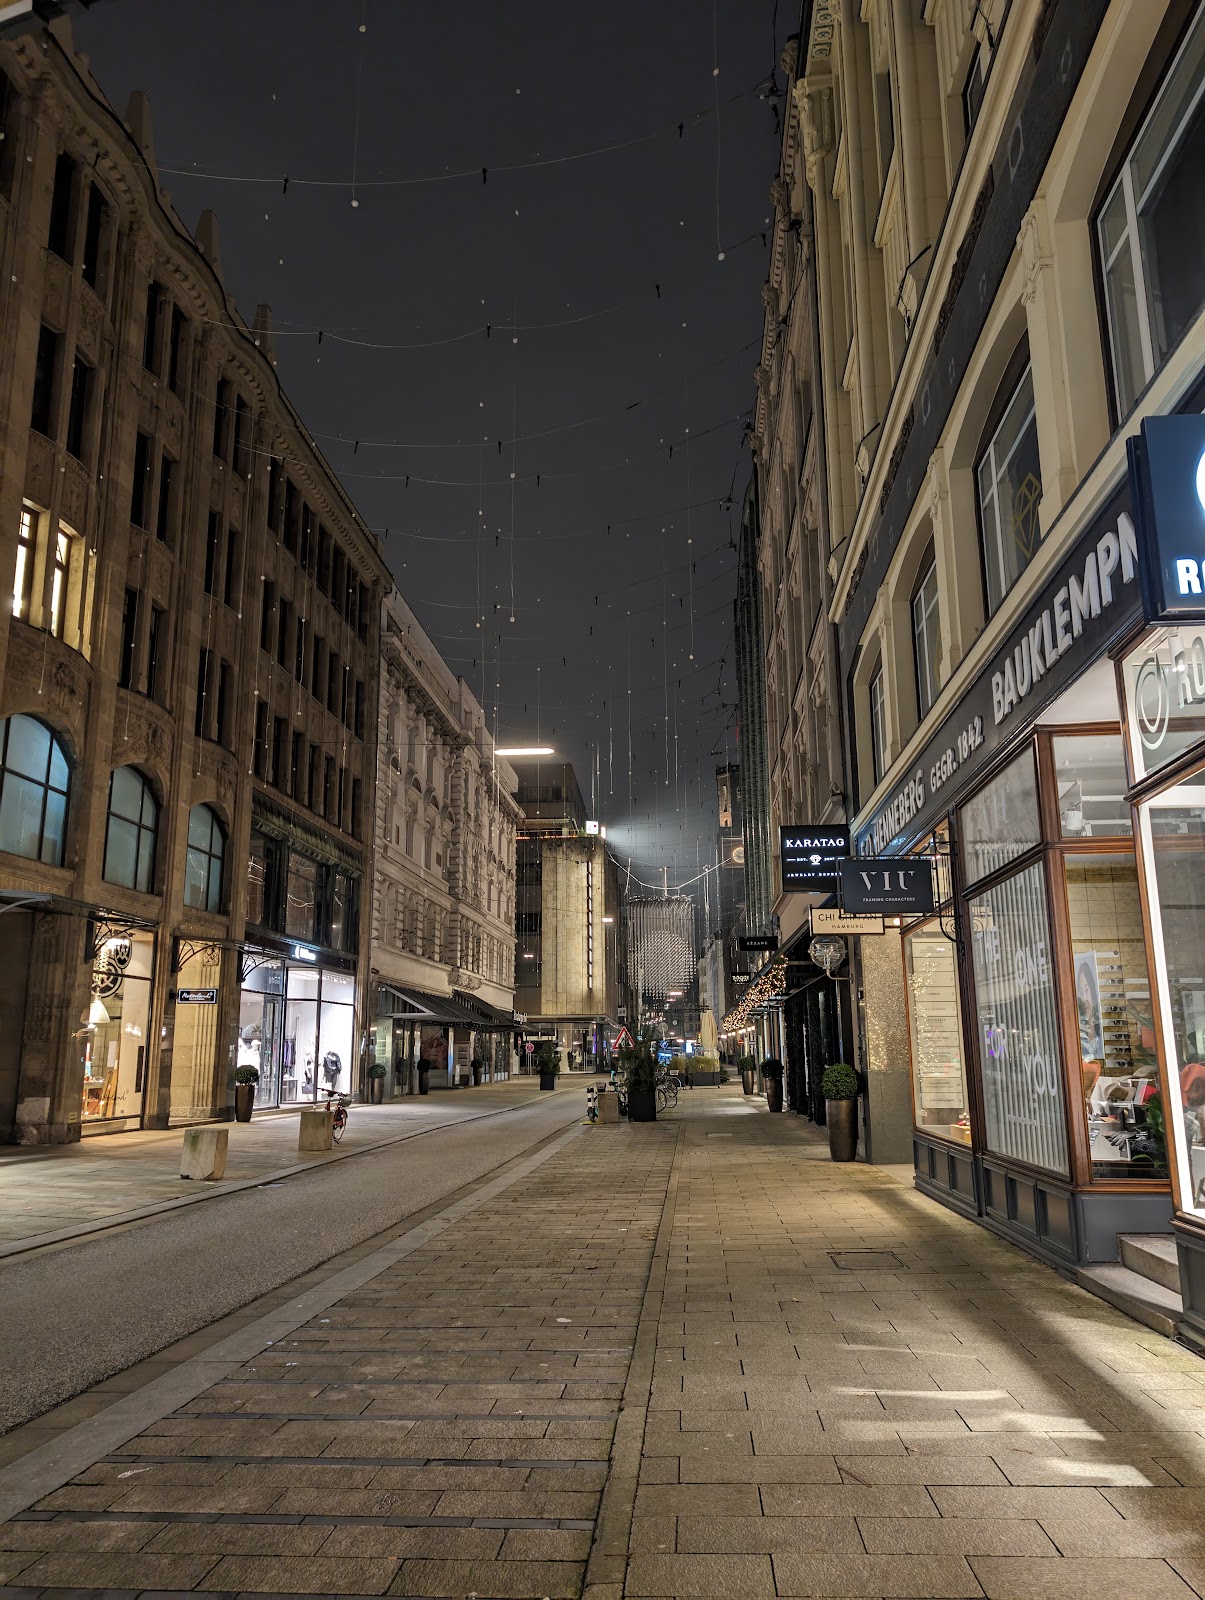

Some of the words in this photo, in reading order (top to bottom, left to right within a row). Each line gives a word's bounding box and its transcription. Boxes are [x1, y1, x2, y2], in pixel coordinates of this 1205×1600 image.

[1176, 558, 1205, 595] R
[874, 768, 927, 856] HENNEBERG
[930, 749, 957, 794] GEGR.
[992, 511, 1139, 726] BAUKLEMPN
[786, 838, 845, 848] KARATAG
[860, 870, 915, 891] VIU
[818, 913, 835, 922] CHI
[976, 926, 1001, 965] THE
[1014, 941, 1047, 988] ONE
[983, 1023, 1009, 1059] FOR
[1022, 1053, 1058, 1097] YOU
